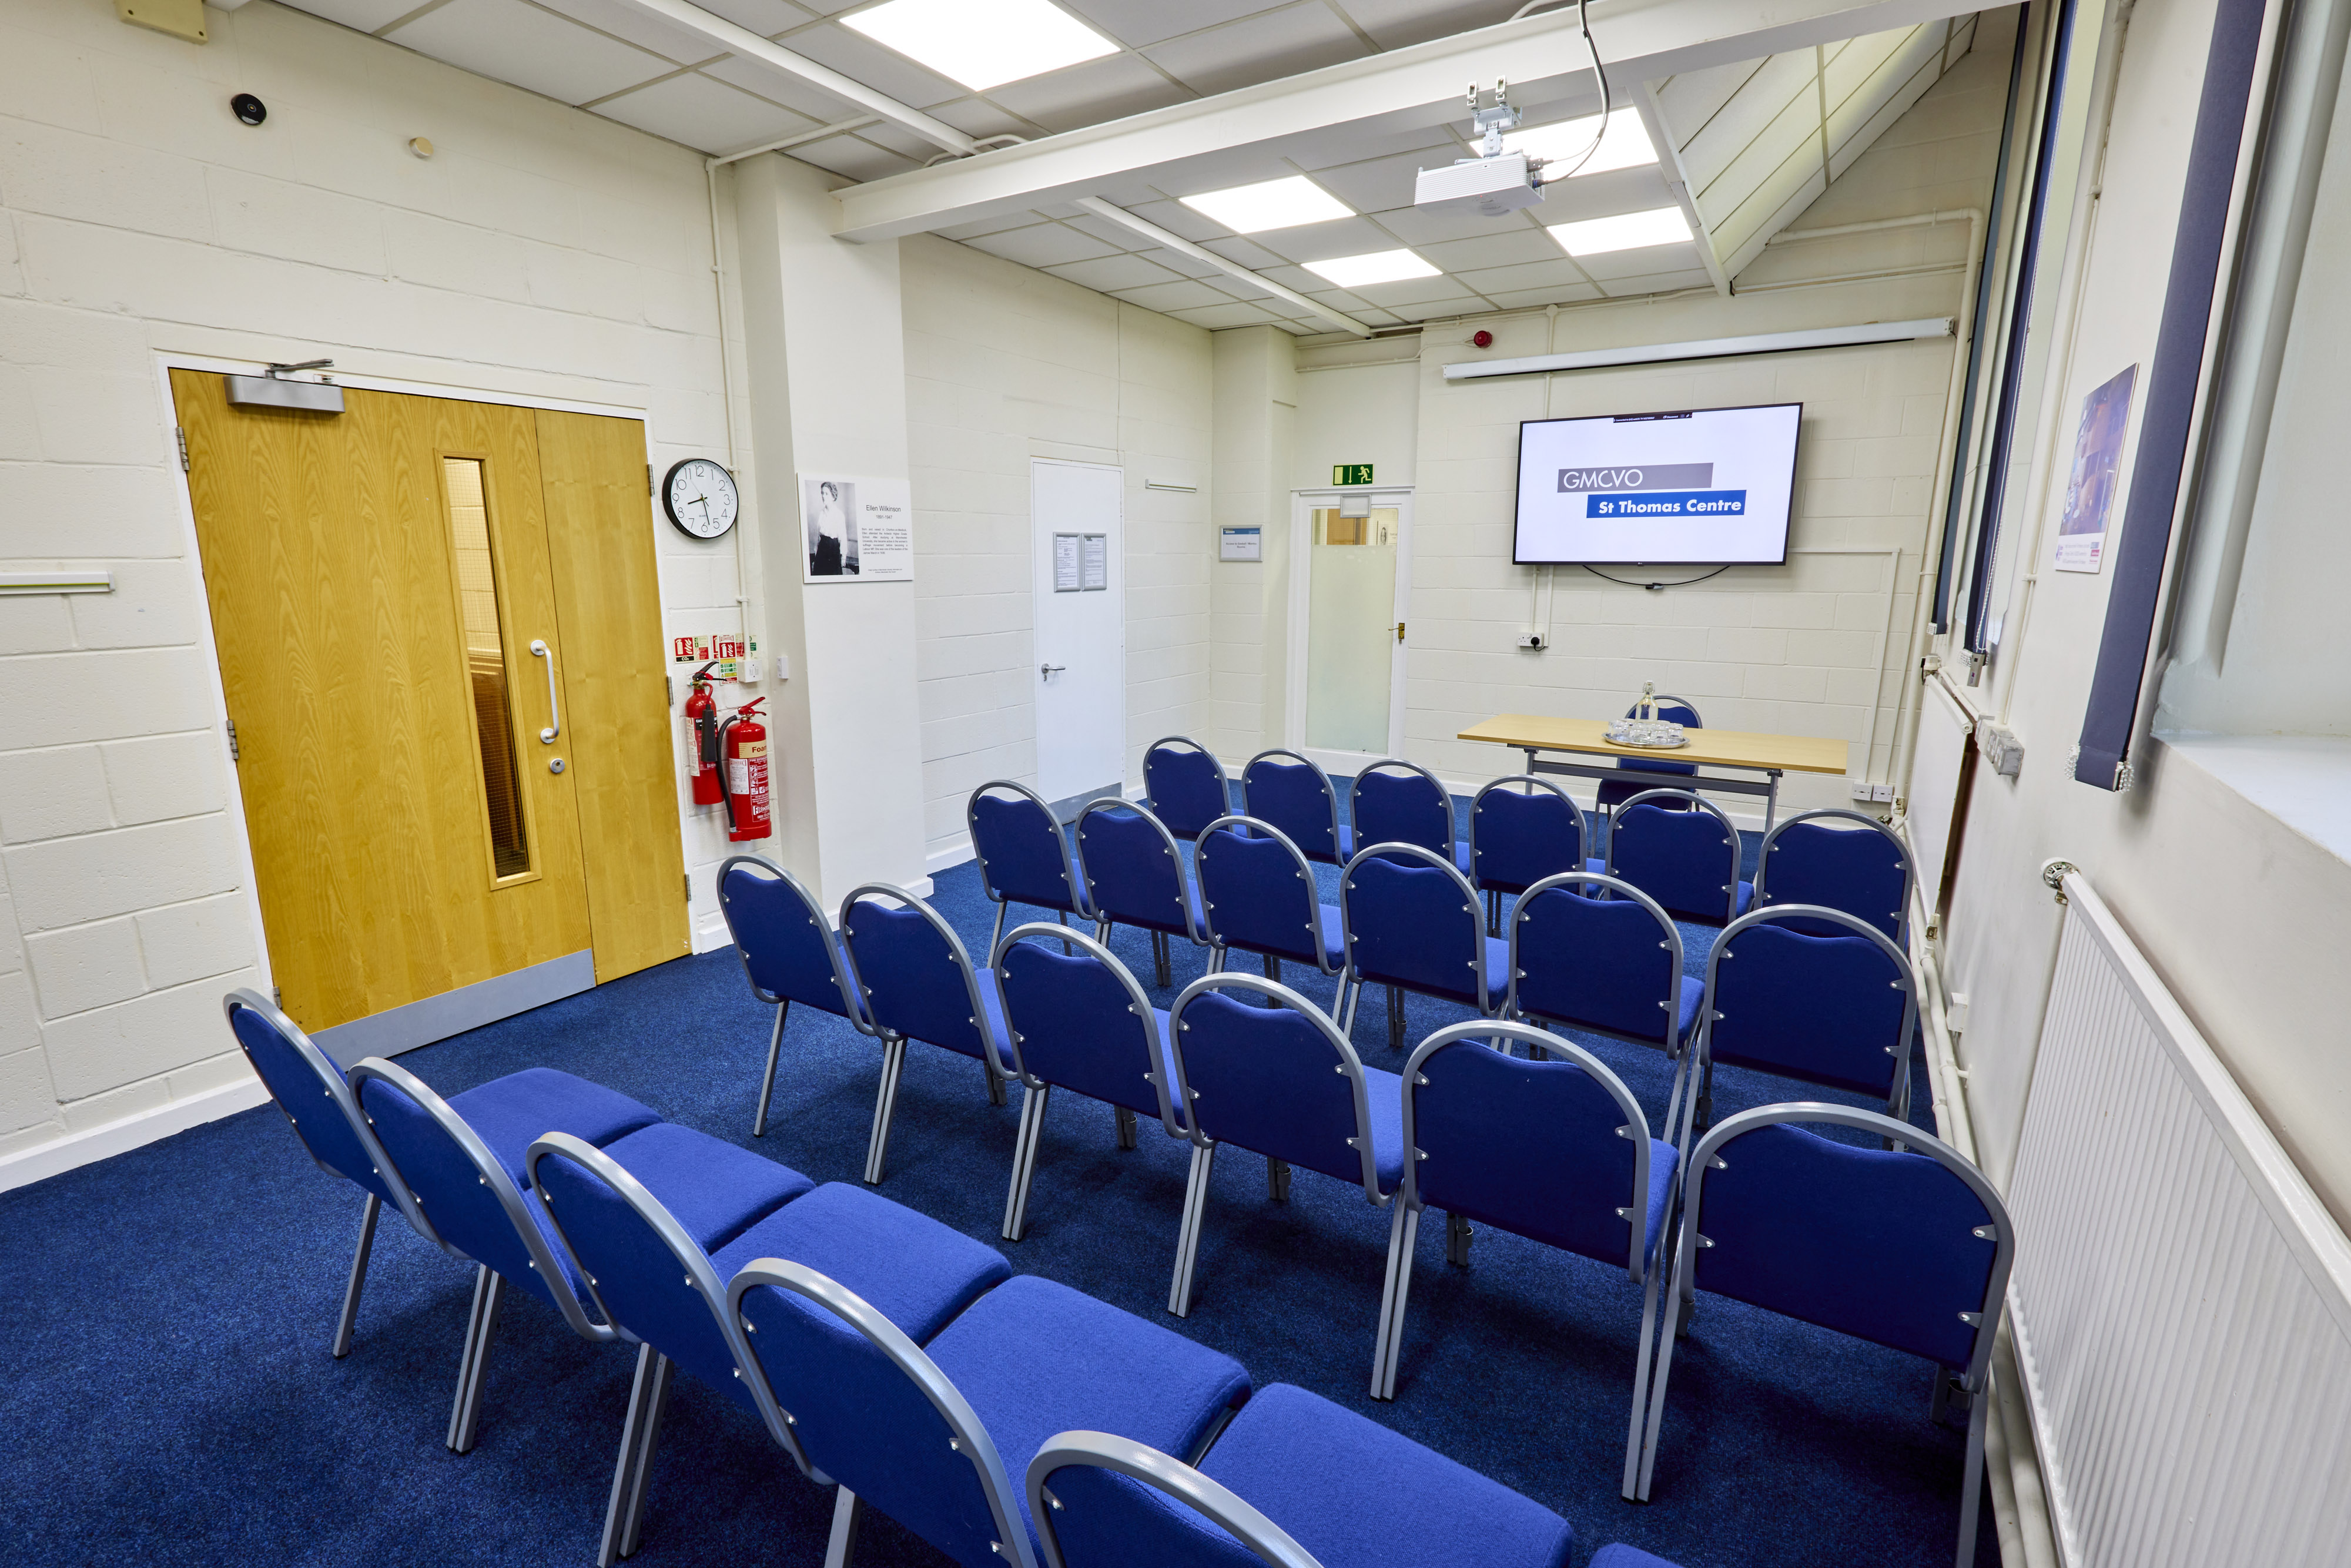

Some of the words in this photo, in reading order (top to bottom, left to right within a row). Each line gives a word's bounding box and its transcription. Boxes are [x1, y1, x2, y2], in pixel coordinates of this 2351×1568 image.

[684, 468, 691, 480] 11
[695, 465, 705, 477] 12
[711, 469, 714, 480] 1
[675, 478, 686, 490] 10
[1563, 468, 1643, 489] GMCVO
[719, 480, 726, 491] 2
[672, 493, 679, 504] 9
[724, 494, 731, 505] 3
[1599, 501, 1614, 514] St
[1619, 500, 1680, 513] Thomas
[1687, 499, 1742, 512] Centre
[677, 507, 685, 518] 8
[721, 508, 728, 519] 4
[688, 518, 695, 529] 7
[701, 522, 708, 532] 6
[713, 518, 720, 529] 5
